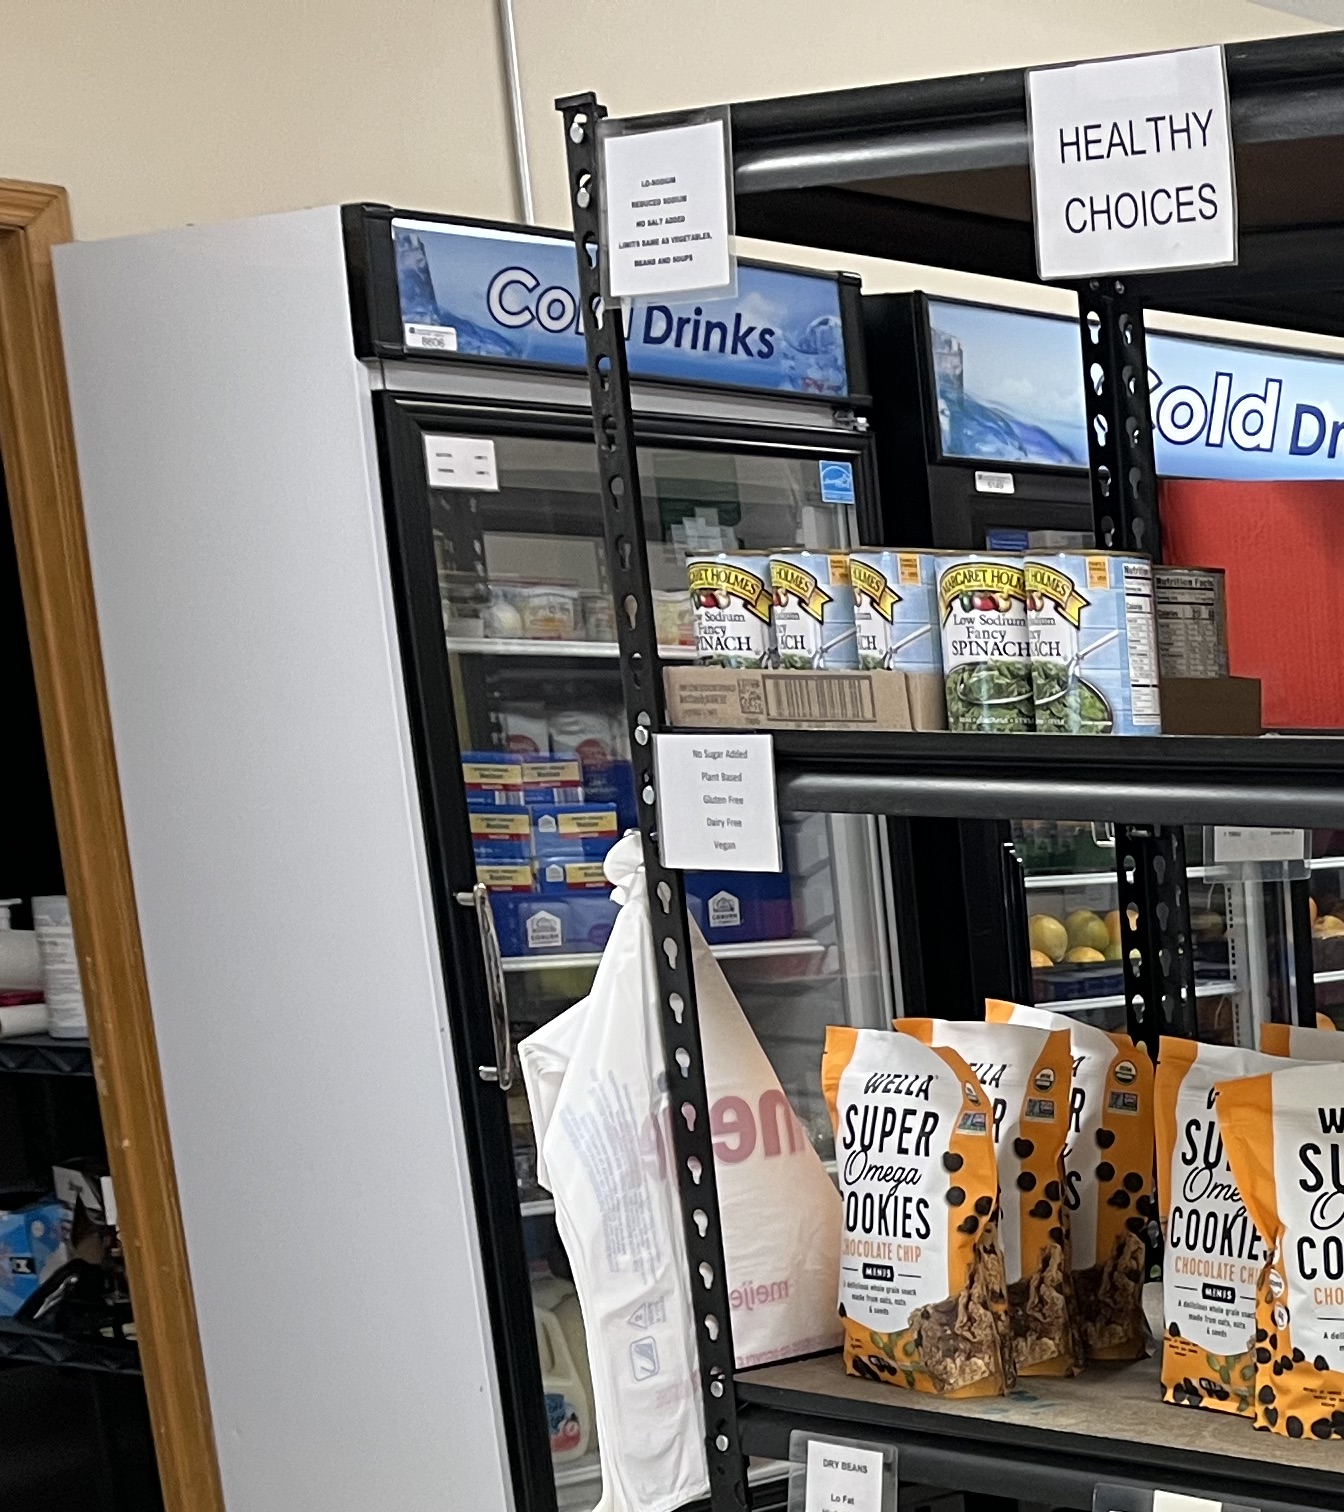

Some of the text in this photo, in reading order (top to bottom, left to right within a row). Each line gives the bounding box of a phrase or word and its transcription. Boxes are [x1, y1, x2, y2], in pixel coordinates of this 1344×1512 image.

[1059, 109, 1213, 163] HEALTHY
[1065, 183, 1217, 234] CHOICES
[643, 305, 775, 359] Drinks
[712, 568, 758, 595] HOLMES
[942, 569, 988, 597] MARGARET
[705, 612, 745, 623] Sodium
[953, 613, 1026, 627] Low Sodium
[966, 627, 1007, 643] Fancy
[952, 640, 1030, 657] SPINACH
[692, 749, 748, 760] No Sugar Added
[701, 772, 742, 782] Plant Based
[703, 795, 744, 805] Gluten Free
[706, 817, 742, 828] Dairy Free
[714, 841, 736, 851] Vegan
[864, 1072, 934, 1101] WELLA
[842, 1104, 939, 1157] SUPER
[844, 1150, 922, 1196] Omega
[843, 1238, 921, 1263] HOCOLATE CHIP
[865, 1266, 891, 1278] MINIS
[1205, 1288, 1233, 1300] MINIS
[1323, 1332, 1329, 1340] A
[823, 1459, 868, 1474] DRY BEANS
[830, 1493, 855, 1505] Lo Fat
